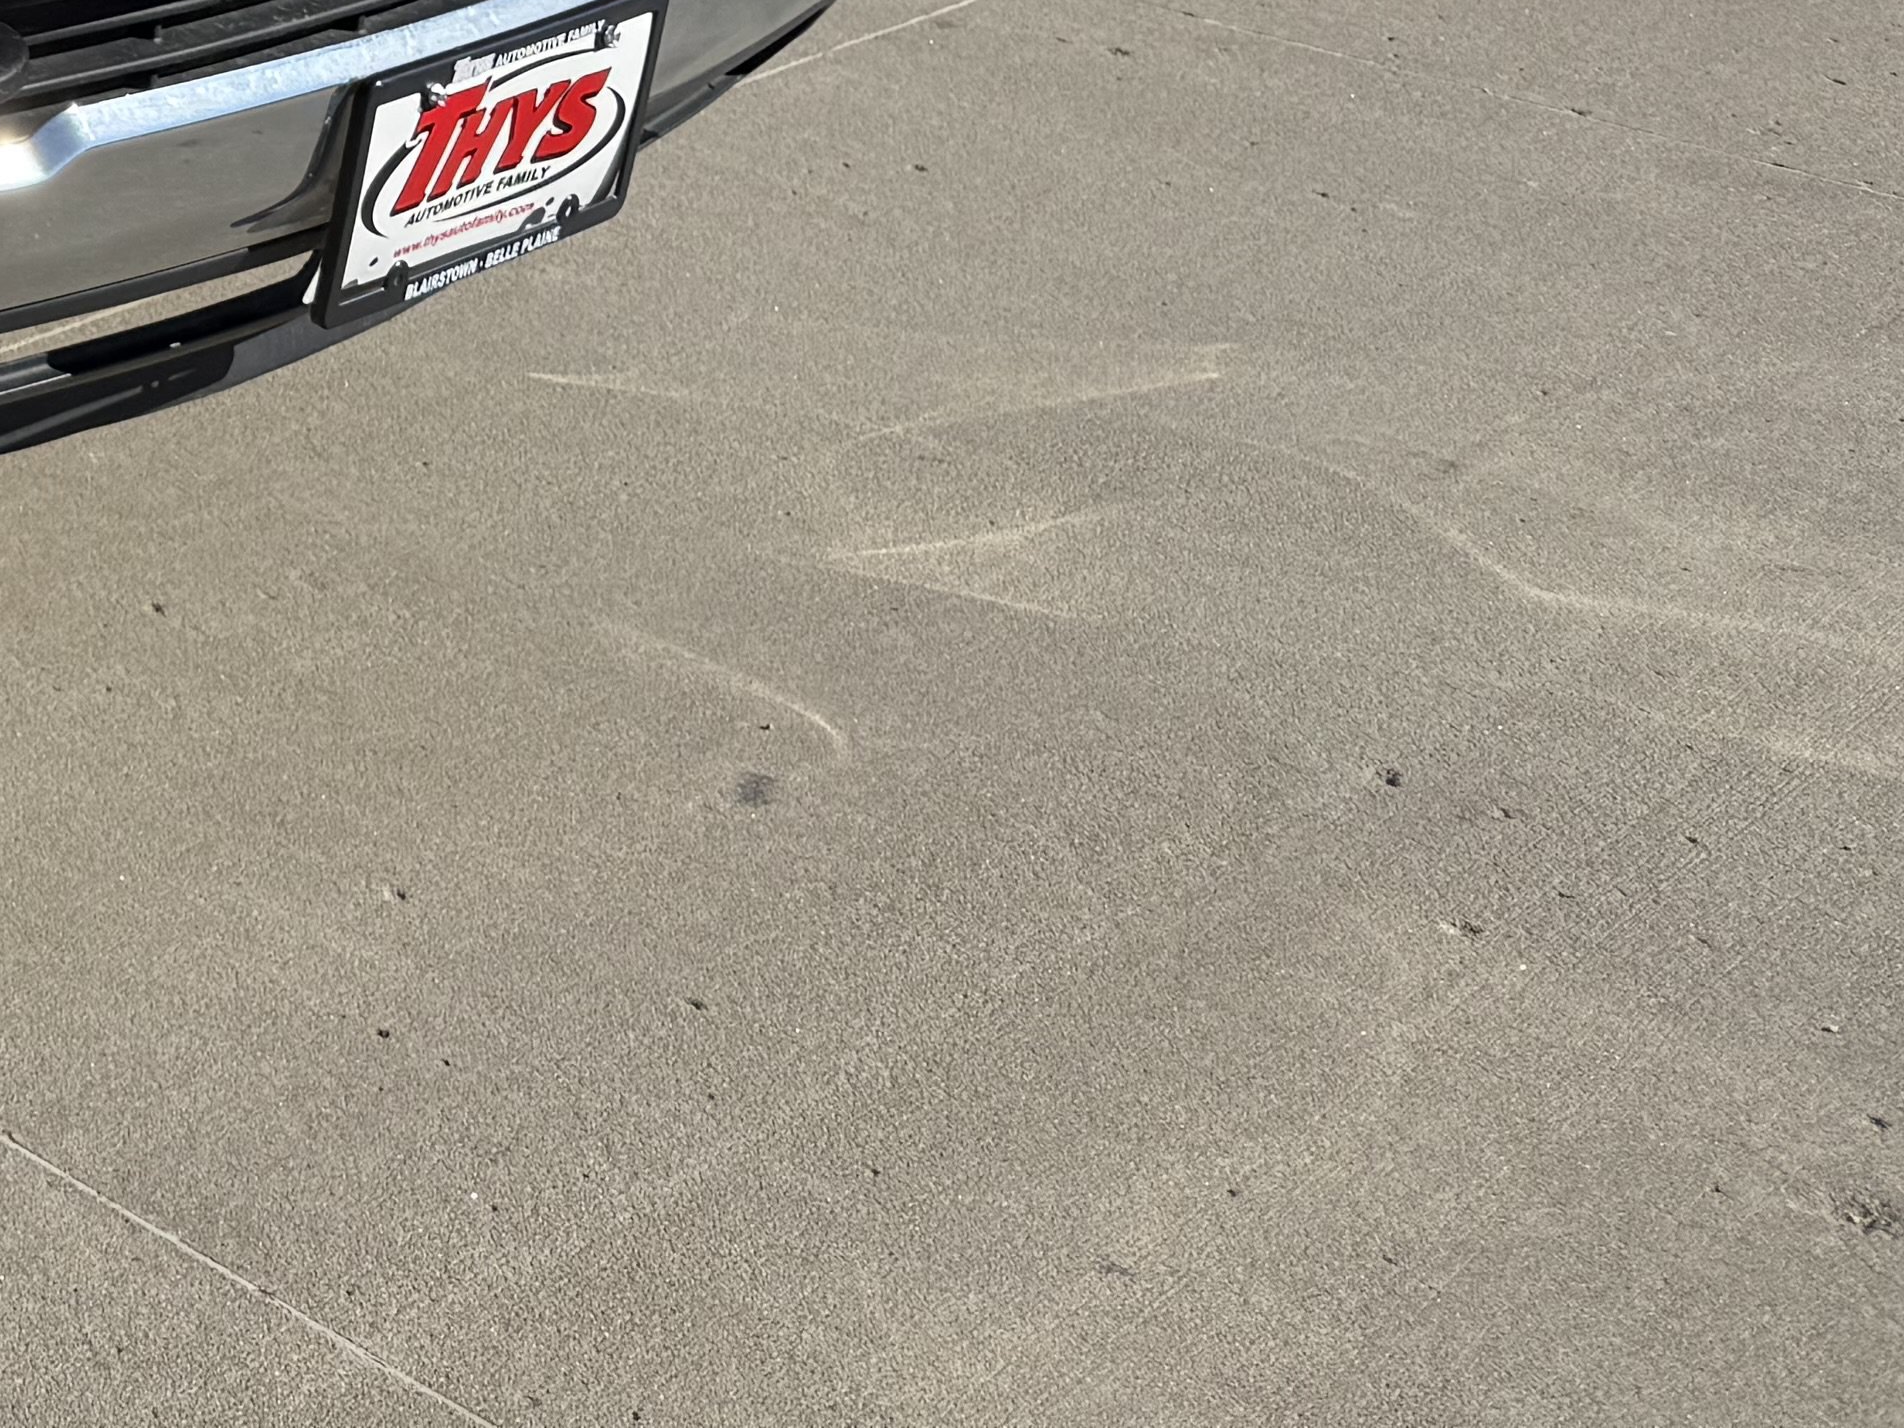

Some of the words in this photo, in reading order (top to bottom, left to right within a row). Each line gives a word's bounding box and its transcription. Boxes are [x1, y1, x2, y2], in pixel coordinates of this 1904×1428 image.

[495, 32, 567, 68] AUTOMOTIVE
[566, 19, 606, 42] FAMILY
[389, 66, 612, 218] THYS
[404, 180, 495, 228] AUTOMOTIVE
[495, 165, 551, 192] FAMILY
[393, 202, 536, 258] www.thysautofamily.com
[405, 258, 479, 301] BLAIRSTOWN
[483, 241, 521, 269] BELLE
[519, 226, 561, 254] PLAINE
